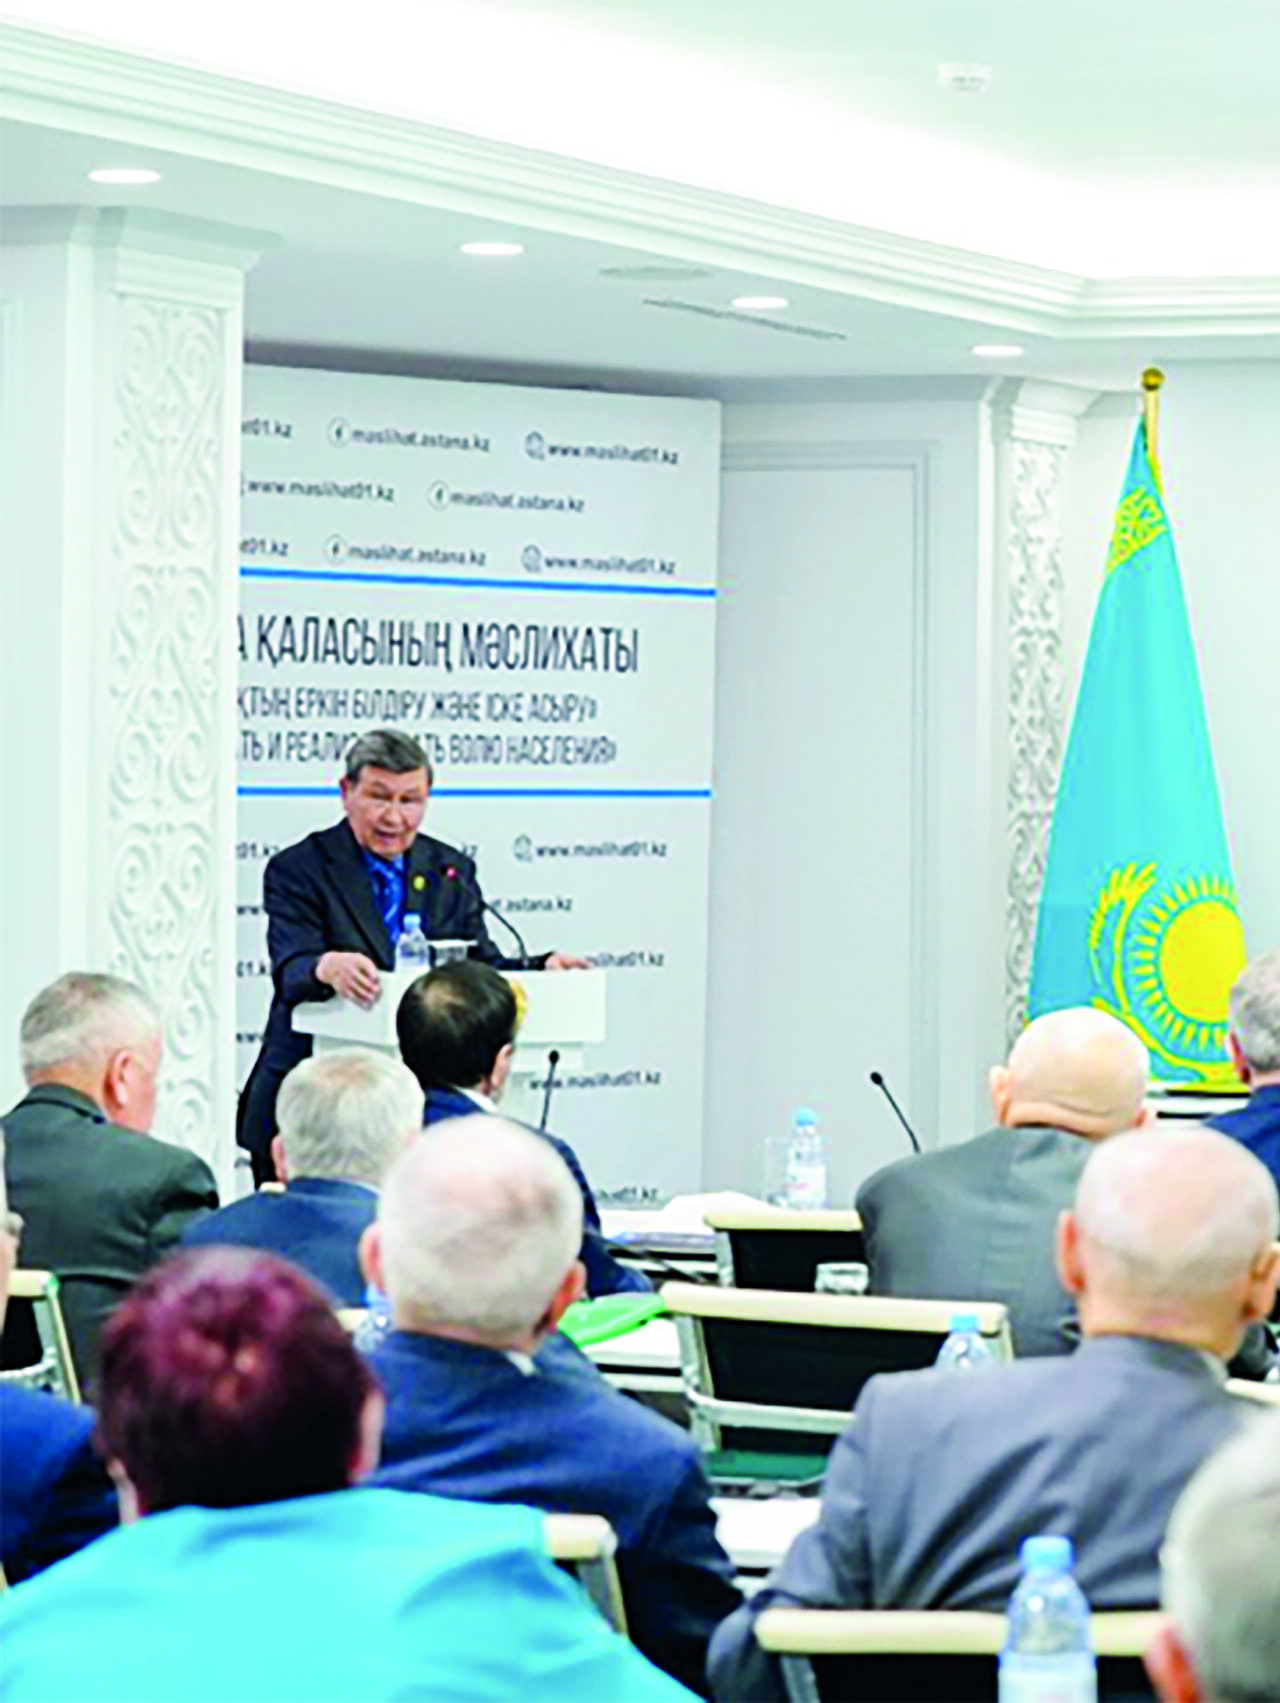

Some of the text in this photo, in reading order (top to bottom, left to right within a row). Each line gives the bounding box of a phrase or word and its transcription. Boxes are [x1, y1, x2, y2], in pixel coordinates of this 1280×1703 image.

[548, 444, 679, 465] www.maslihat01.kz
[248, 479, 395, 502] www.maslihat01.kz
[545, 556, 676, 574] www.maslihat01.kz
[257, 615, 453, 673] ҚАЛАСЫНЫҢ
[459, 622, 639, 673] МӘСЛИХАТЫ
[536, 840, 668, 857] www.maslihat01.kz
